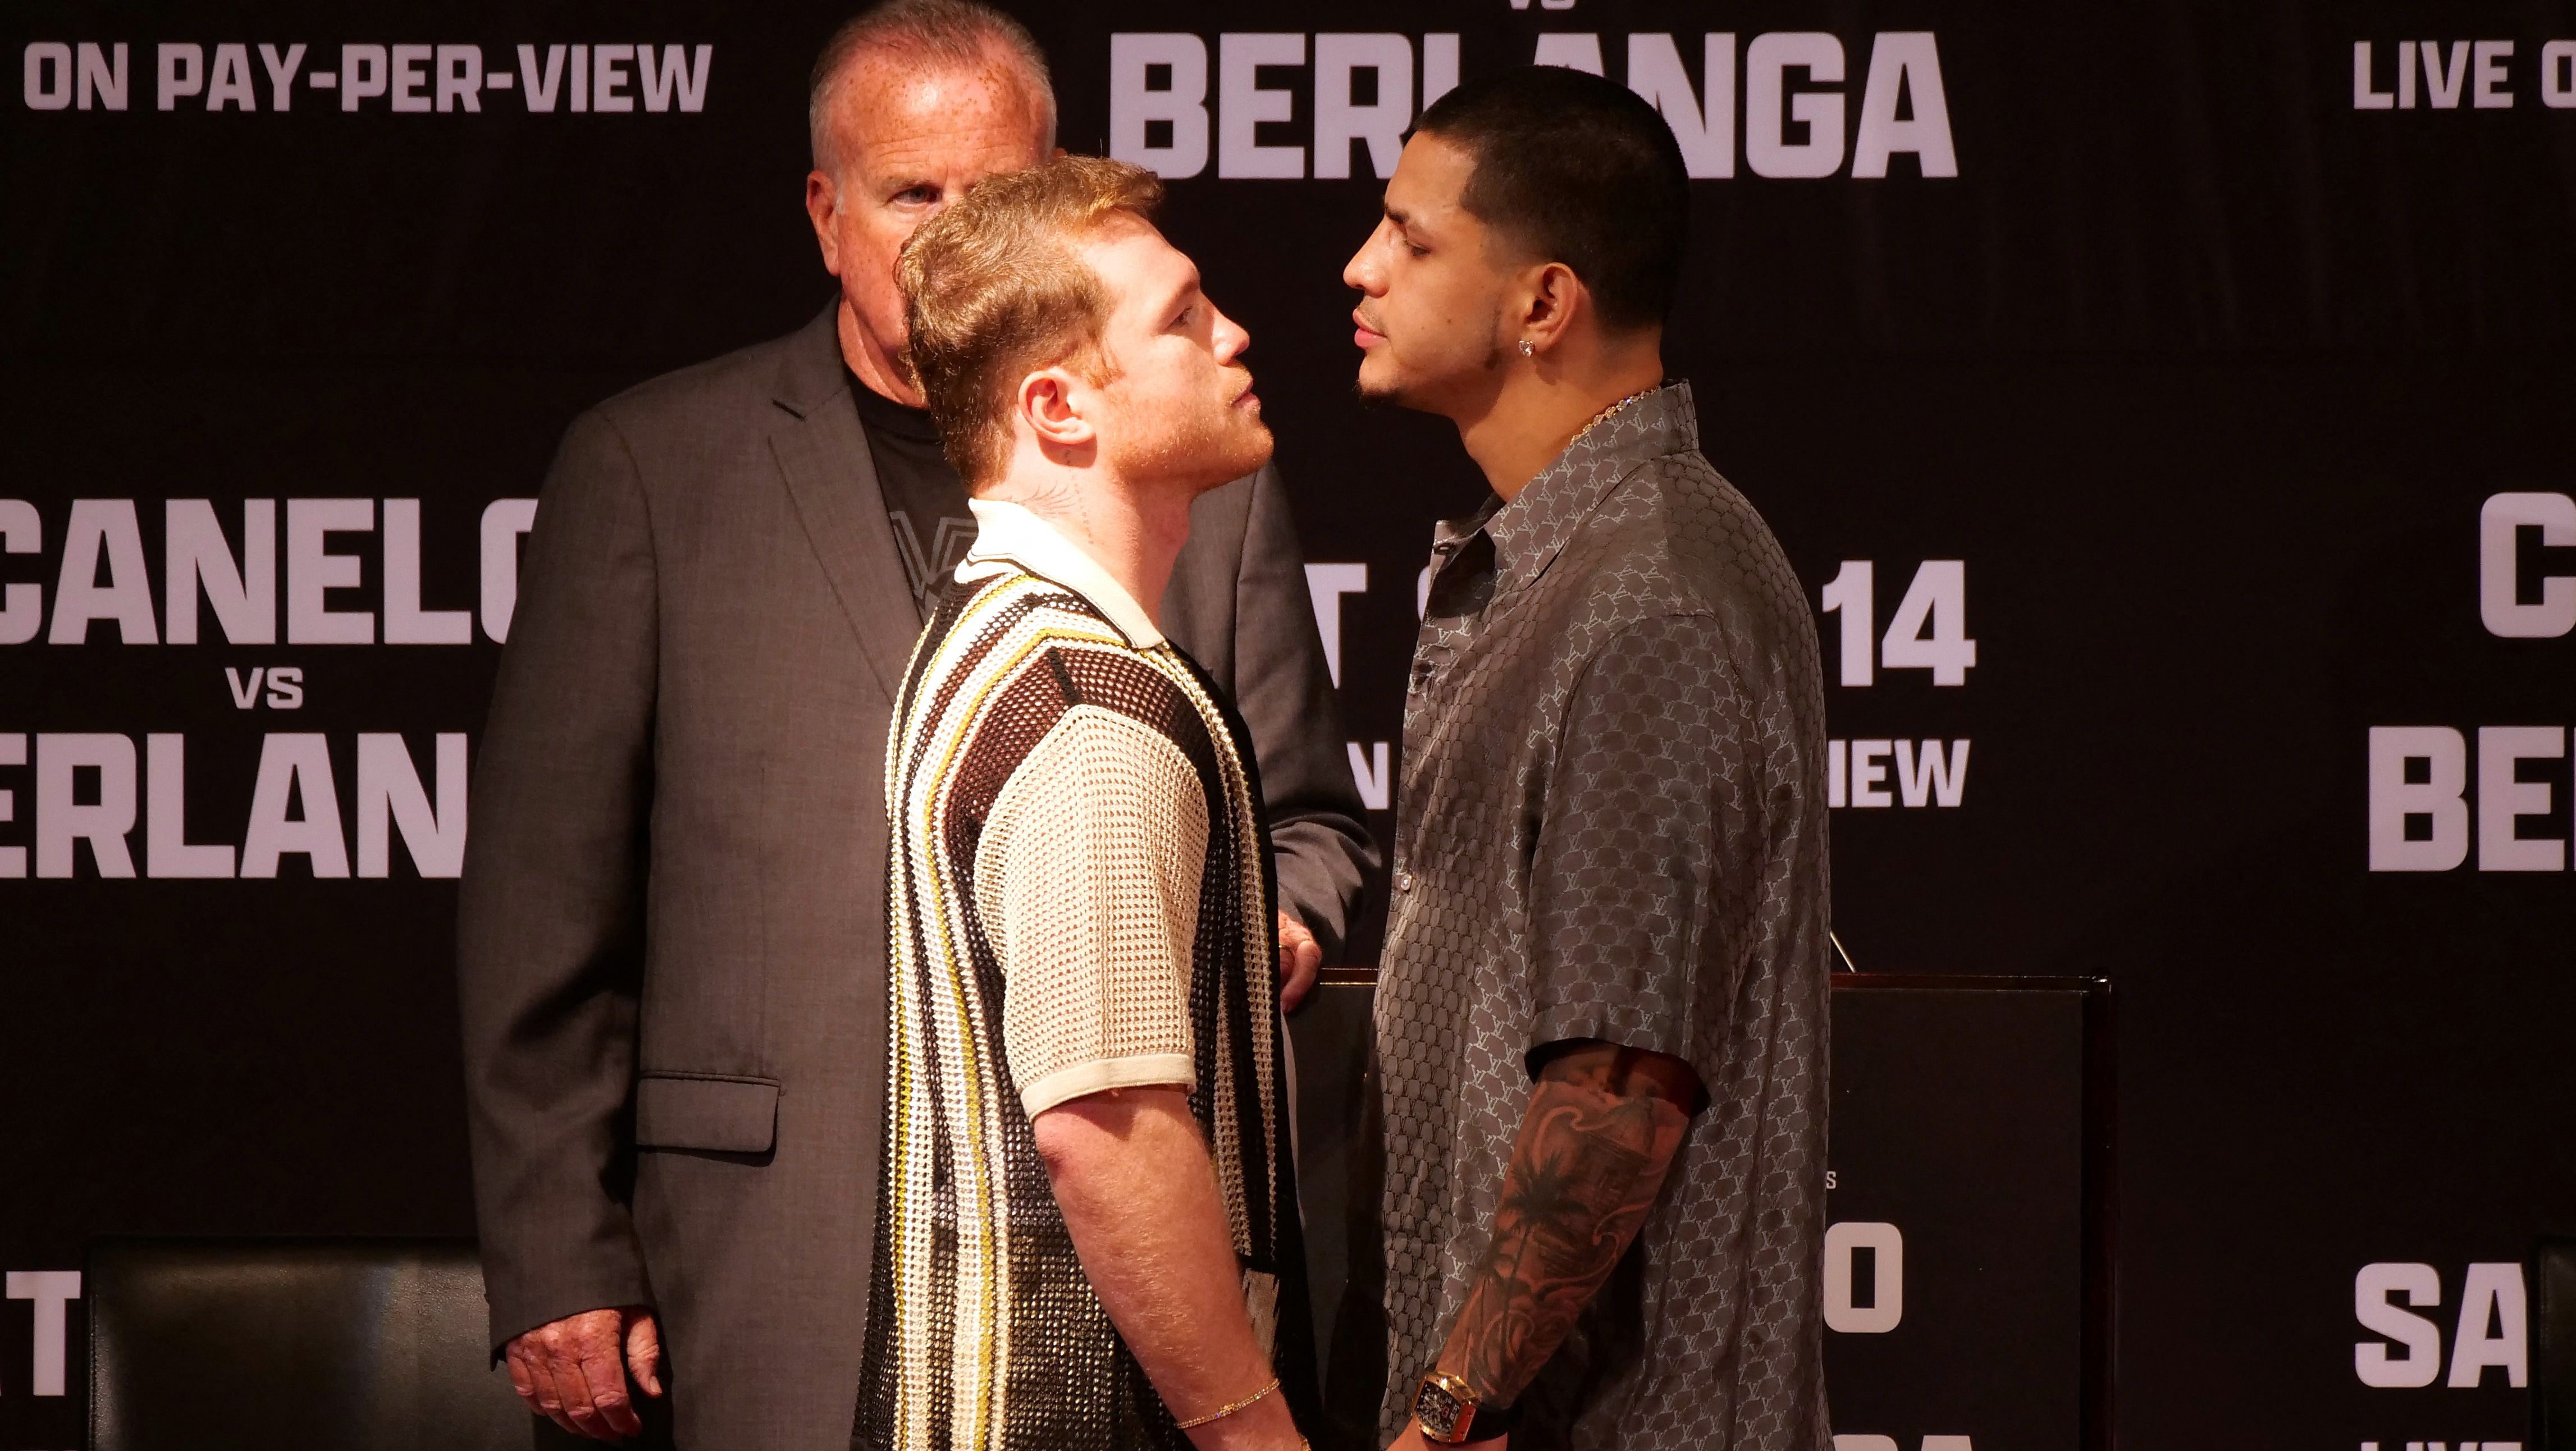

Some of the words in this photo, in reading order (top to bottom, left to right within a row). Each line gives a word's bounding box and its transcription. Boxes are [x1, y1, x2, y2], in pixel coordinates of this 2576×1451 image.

[24, 43, 129, 111] ON
[157, 43, 713, 112] PAY-PER-VIEW
[1110, 31, 1959, 180] BERNGA
[2353, 40, 2515, 109] LIVE
[1822, 560, 1976, 687] 14
[225, 666, 303, 710] VS
[1827, 739, 1971, 808] IEW
[2369, 726, 2576, 872] BE
[2355, 1262, 2528, 1388] SA
